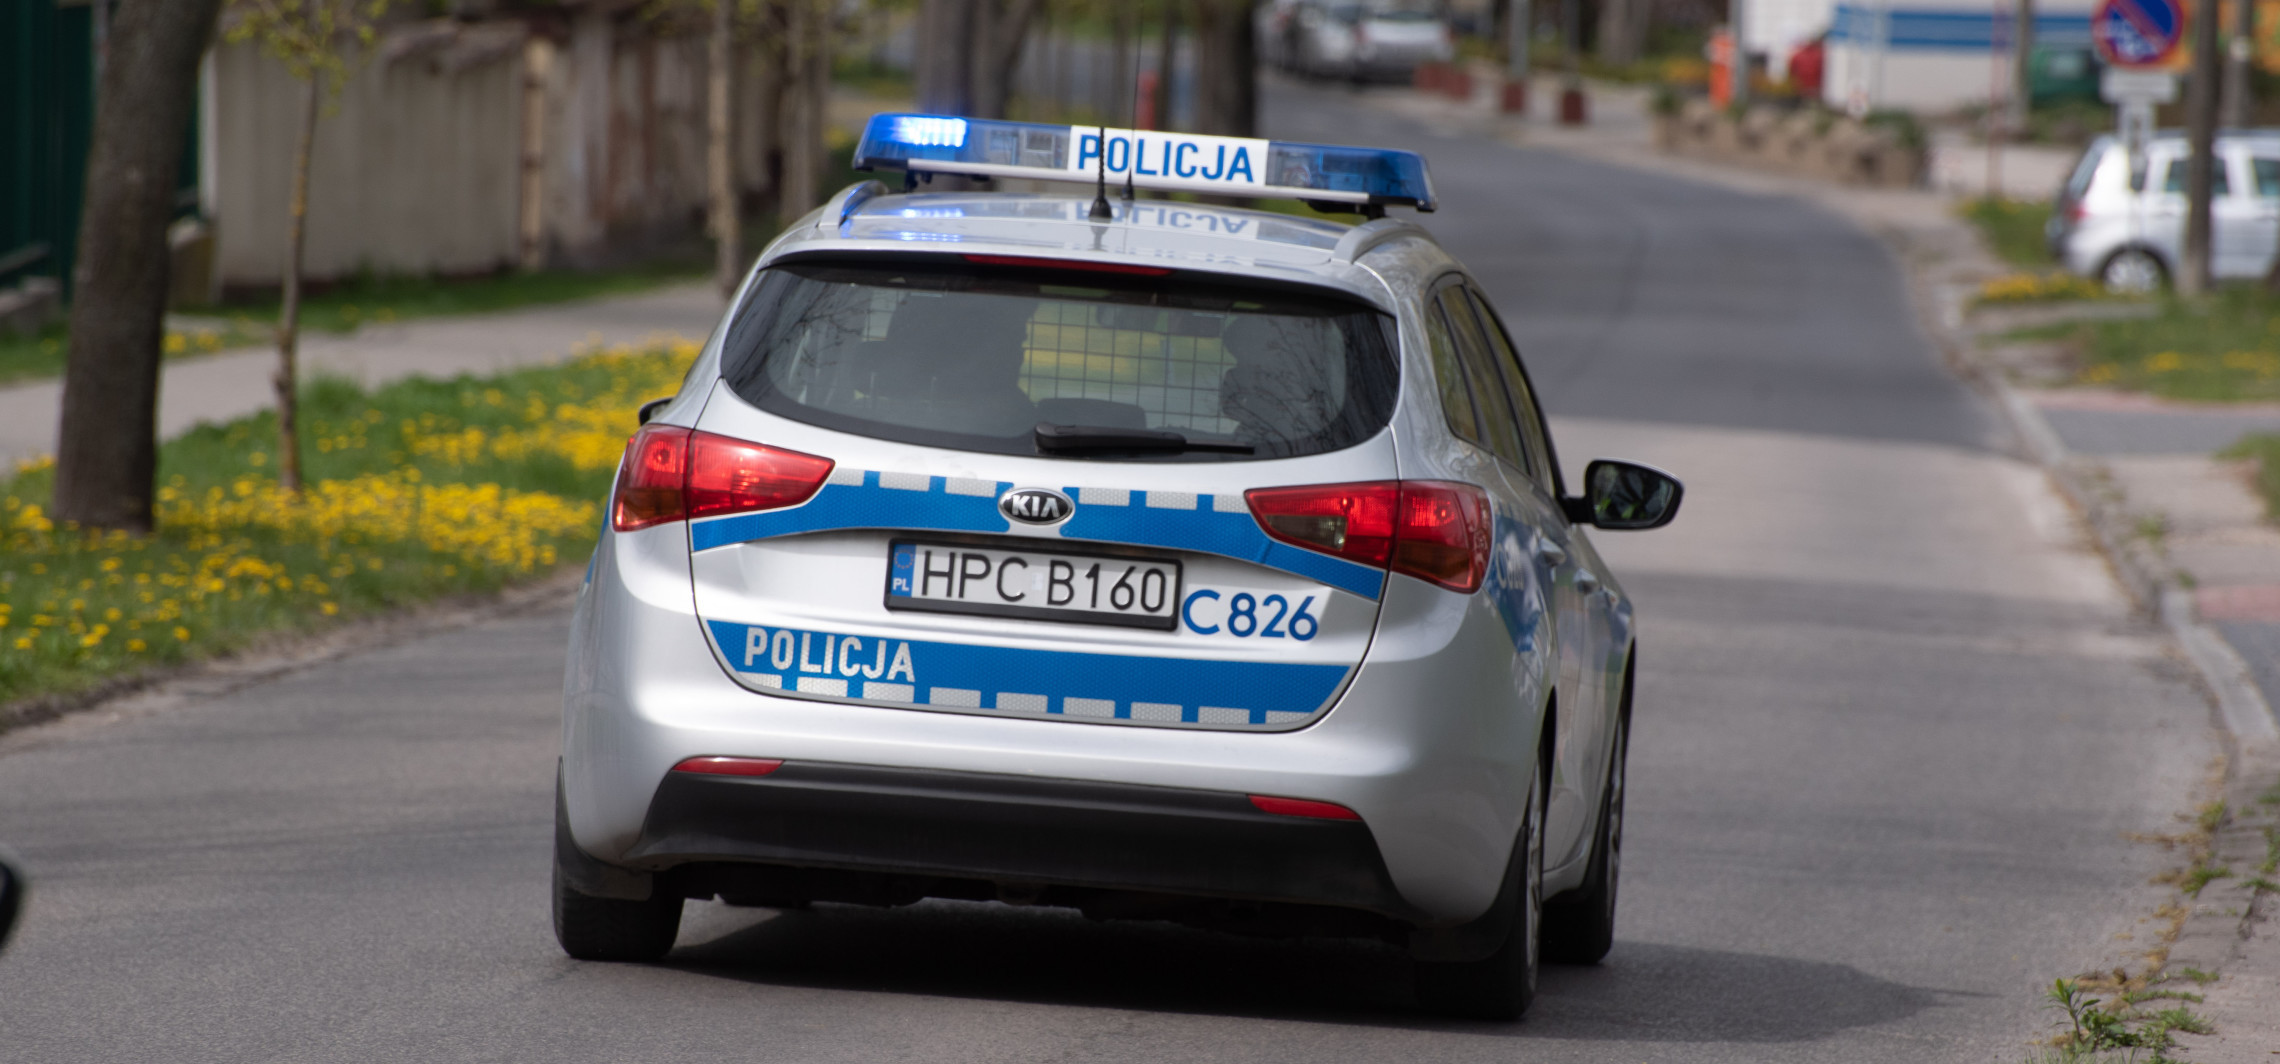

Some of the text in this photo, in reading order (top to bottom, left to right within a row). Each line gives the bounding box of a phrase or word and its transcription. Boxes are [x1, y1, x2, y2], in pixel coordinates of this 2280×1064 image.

[1078, 134, 1254, 183] POLICJA
[1012, 494, 1060, 518] KIA
[893, 577, 910, 591] PL
[921, 550, 1166, 613] HPC B160
[1182, 589, 1318, 641] C826
[744, 627, 915, 682] POLICJA
